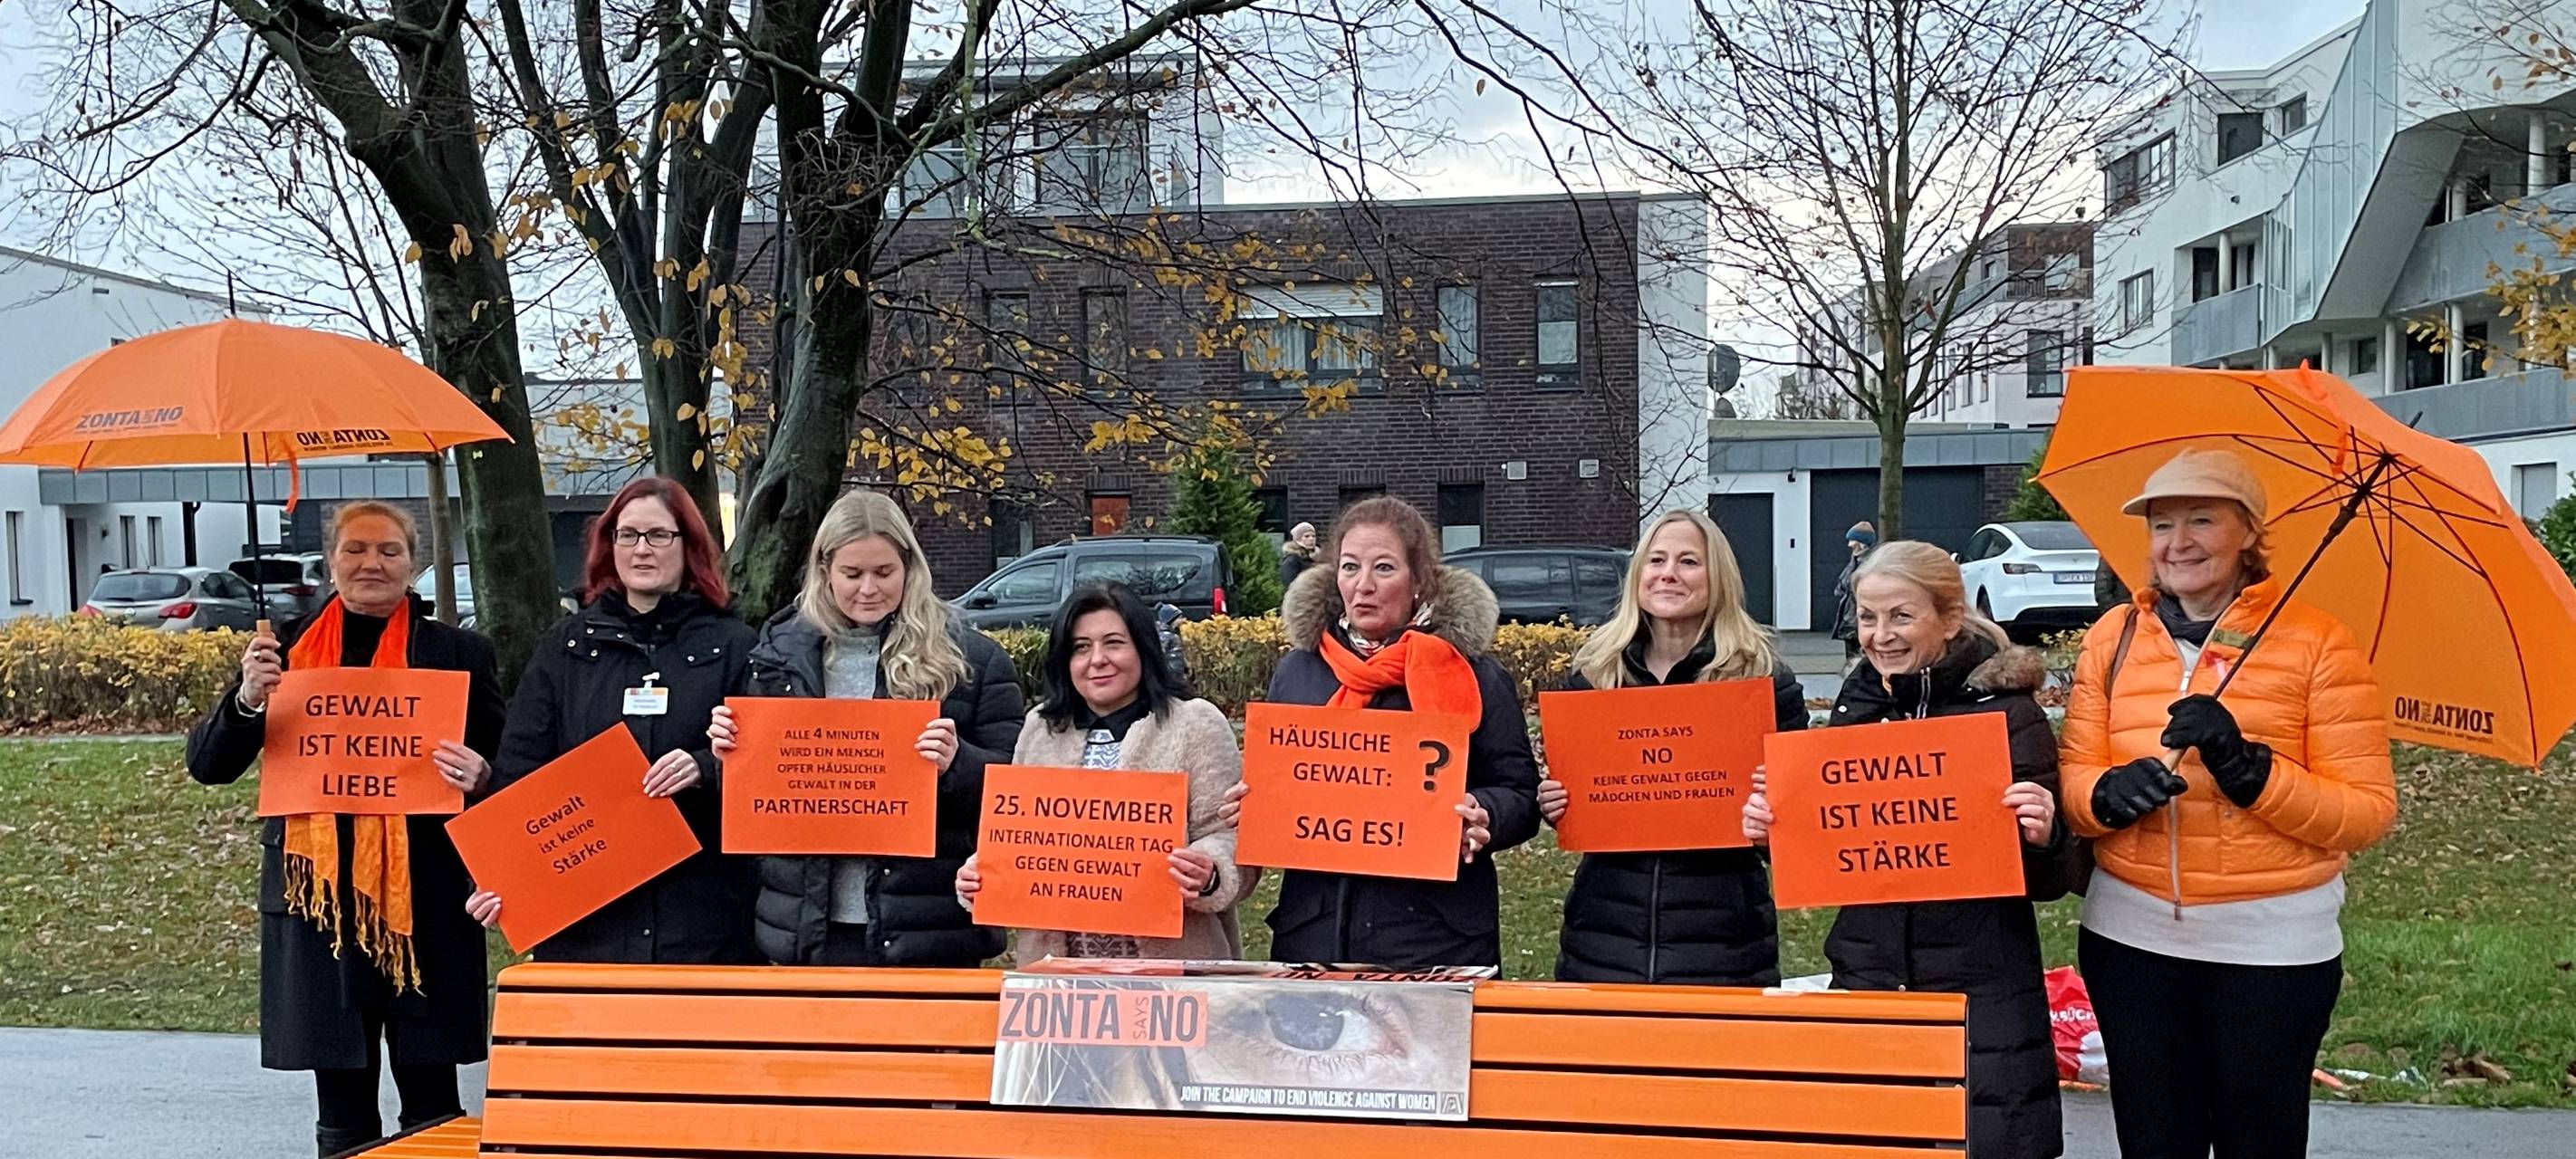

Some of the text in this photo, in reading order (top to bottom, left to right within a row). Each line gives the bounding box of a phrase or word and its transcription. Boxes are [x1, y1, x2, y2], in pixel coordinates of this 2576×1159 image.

[75, 410, 141, 429] ZONTA
[154, 406, 184, 423] NO
[305, 694, 421, 719] GEWALT
[784, 726, 879, 742] ALLE 4 MINUTEN
[1270, 723, 1391, 754] HÄUSLICHE
[1618, 724, 1694, 741] ZONTA SAYS
[299, 733, 422, 759] IST KEINE
[780, 746, 884, 760] WIRD EIN MENSCH
[1642, 746, 1673, 765] NO
[777, 761, 886, 775] OPFER HÄUSLICHER
[1293, 761, 1392, 788] GEWALT:
[1418, 739, 1450, 792] ?
[1821, 751, 1946, 786] GEWALT
[322, 773, 397, 799] LIEBE
[788, 779, 876, 791] GEWALT IN DER
[1593, 770, 1727, 788] KEINE GEWALT GEGEN
[754, 798, 908, 817] PARTNERSCHAFT
[1588, 786, 1735, 804] MÄDCHEN UND FRAUEN
[525, 795, 586, 835] Gewalt
[994, 793, 1172, 825] 25. NOVEMBER
[1820, 796, 1958, 830] IST KEINE
[538, 819, 595, 854] ist keine
[989, 828, 1173, 855] INTERNATIONALER TAG
[1295, 815, 1404, 848] SAG ES!
[553, 839, 608, 875] Stärke
[1015, 854, 1141, 878] GEGEN GEWALT
[1838, 839, 1950, 874] STÄRKE
[1030, 881, 1122, 903] AN FRAUEN
[1002, 992, 1198, 1040] ZONTA SAYS NO
[1180, 1086, 1436, 1110] JOIN THE CAMPAIGN TO END VIOLENCE AGAINST WOMEN
